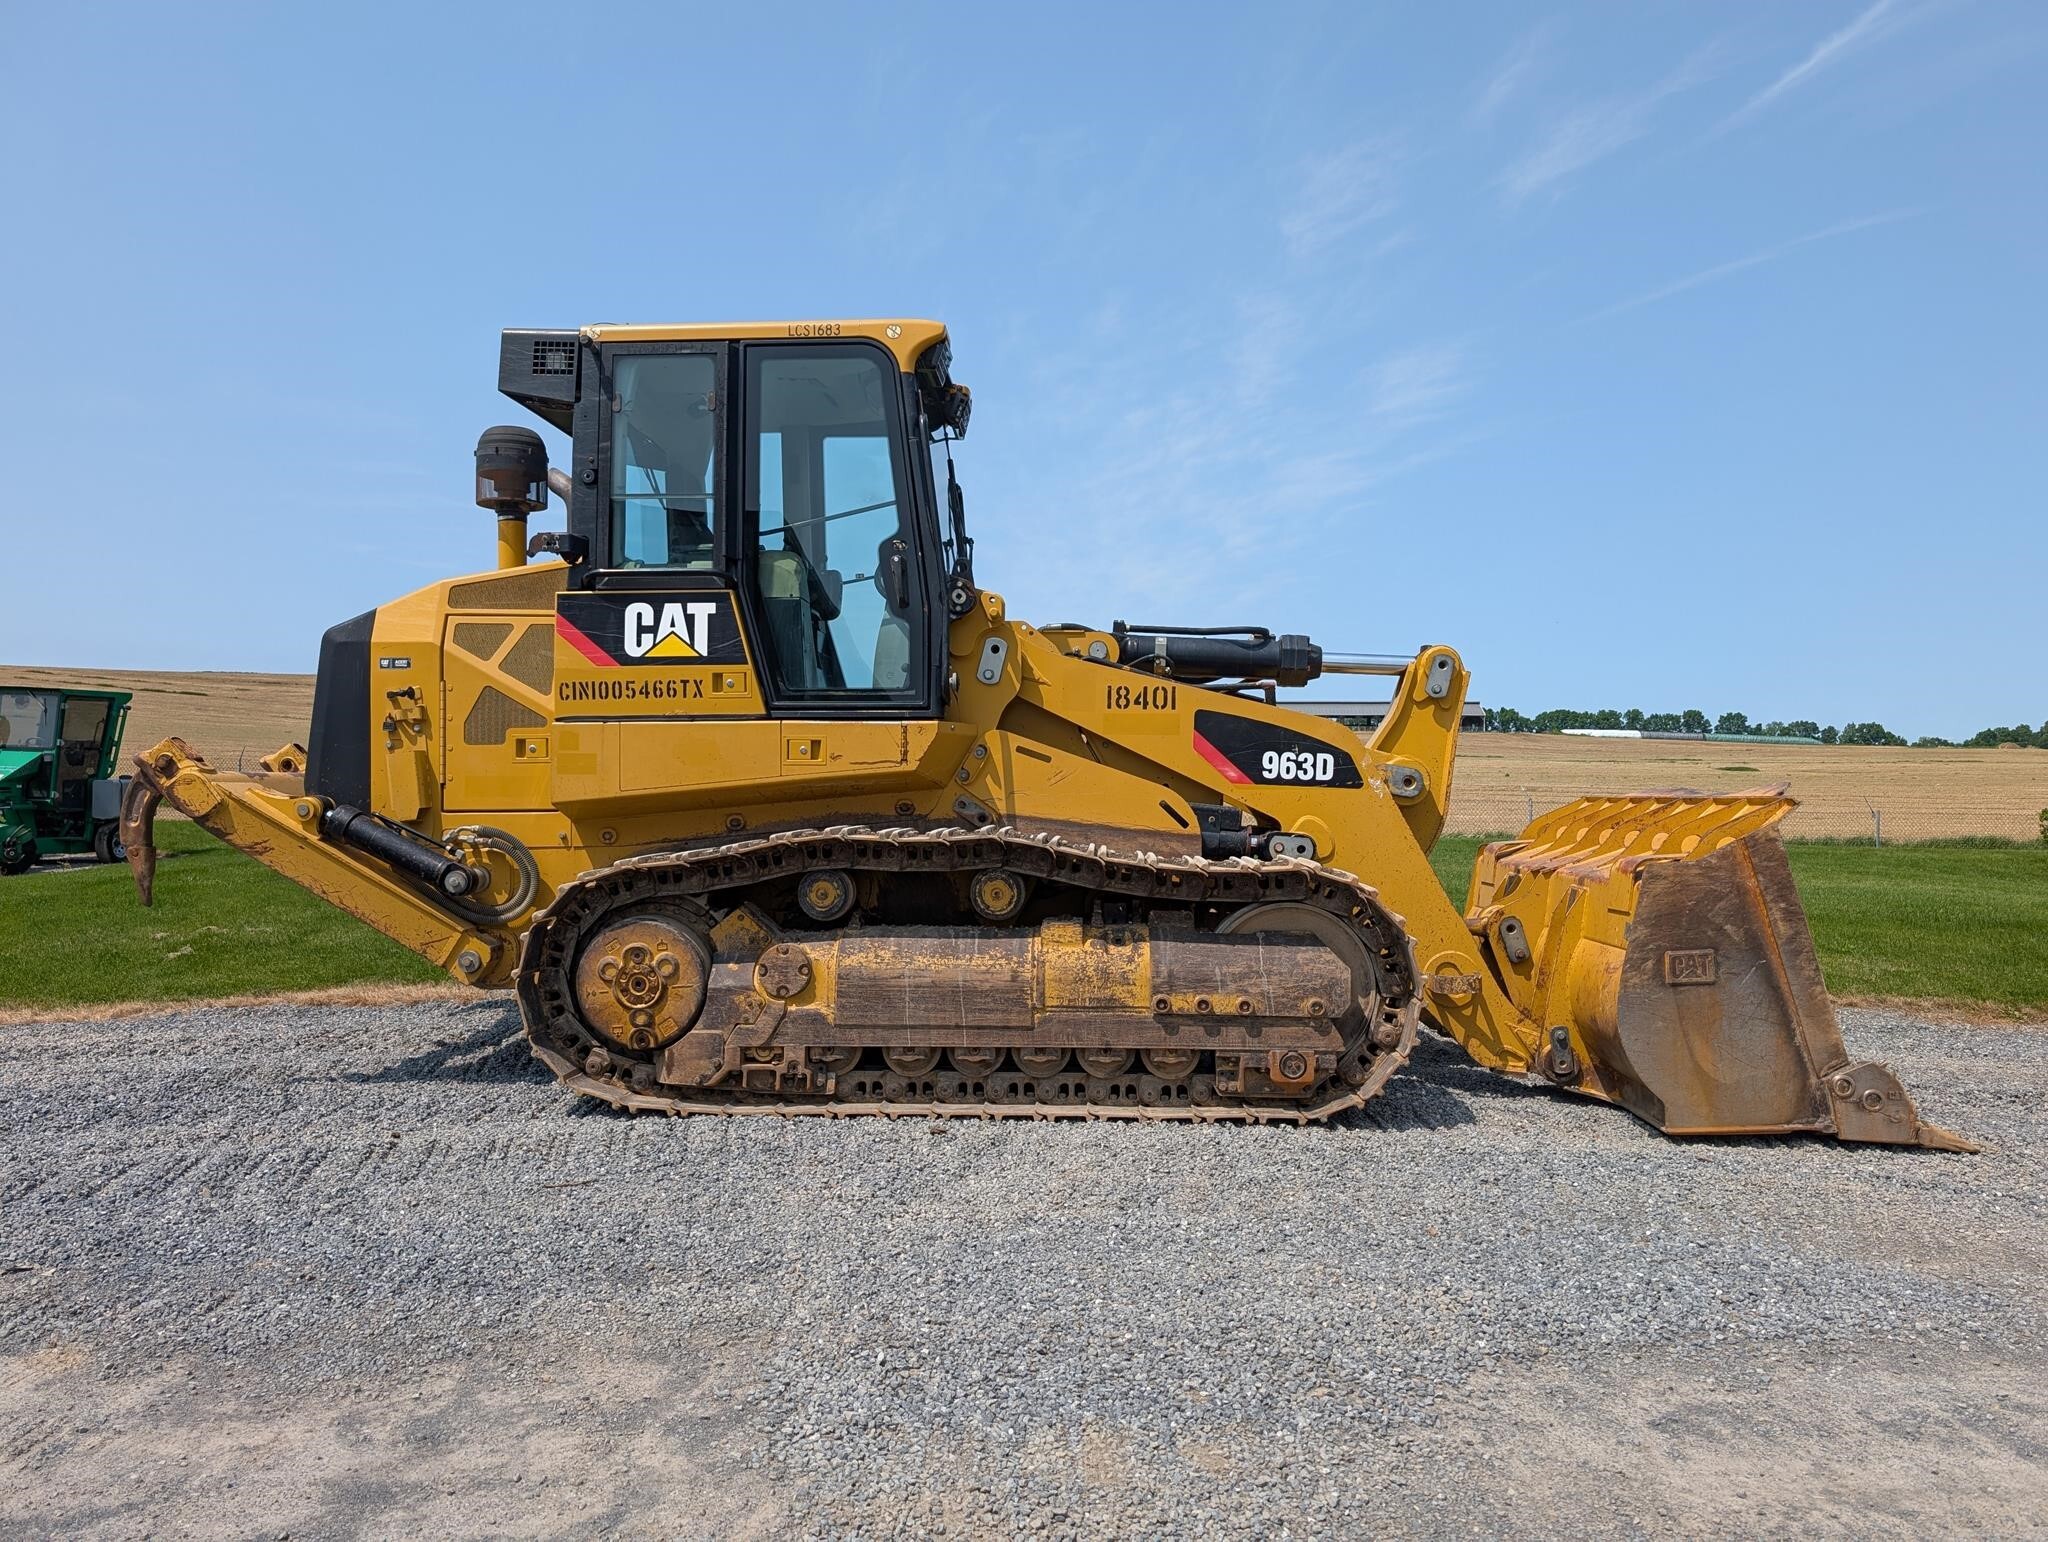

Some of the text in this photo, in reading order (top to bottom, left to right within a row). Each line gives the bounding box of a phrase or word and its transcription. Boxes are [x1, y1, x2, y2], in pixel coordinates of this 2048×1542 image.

[788, 323, 841, 337] LCS1683
[624, 602, 716, 657] CAT
[1106, 685, 1177, 710] 18401
[1261, 750, 1334, 781] 963D
